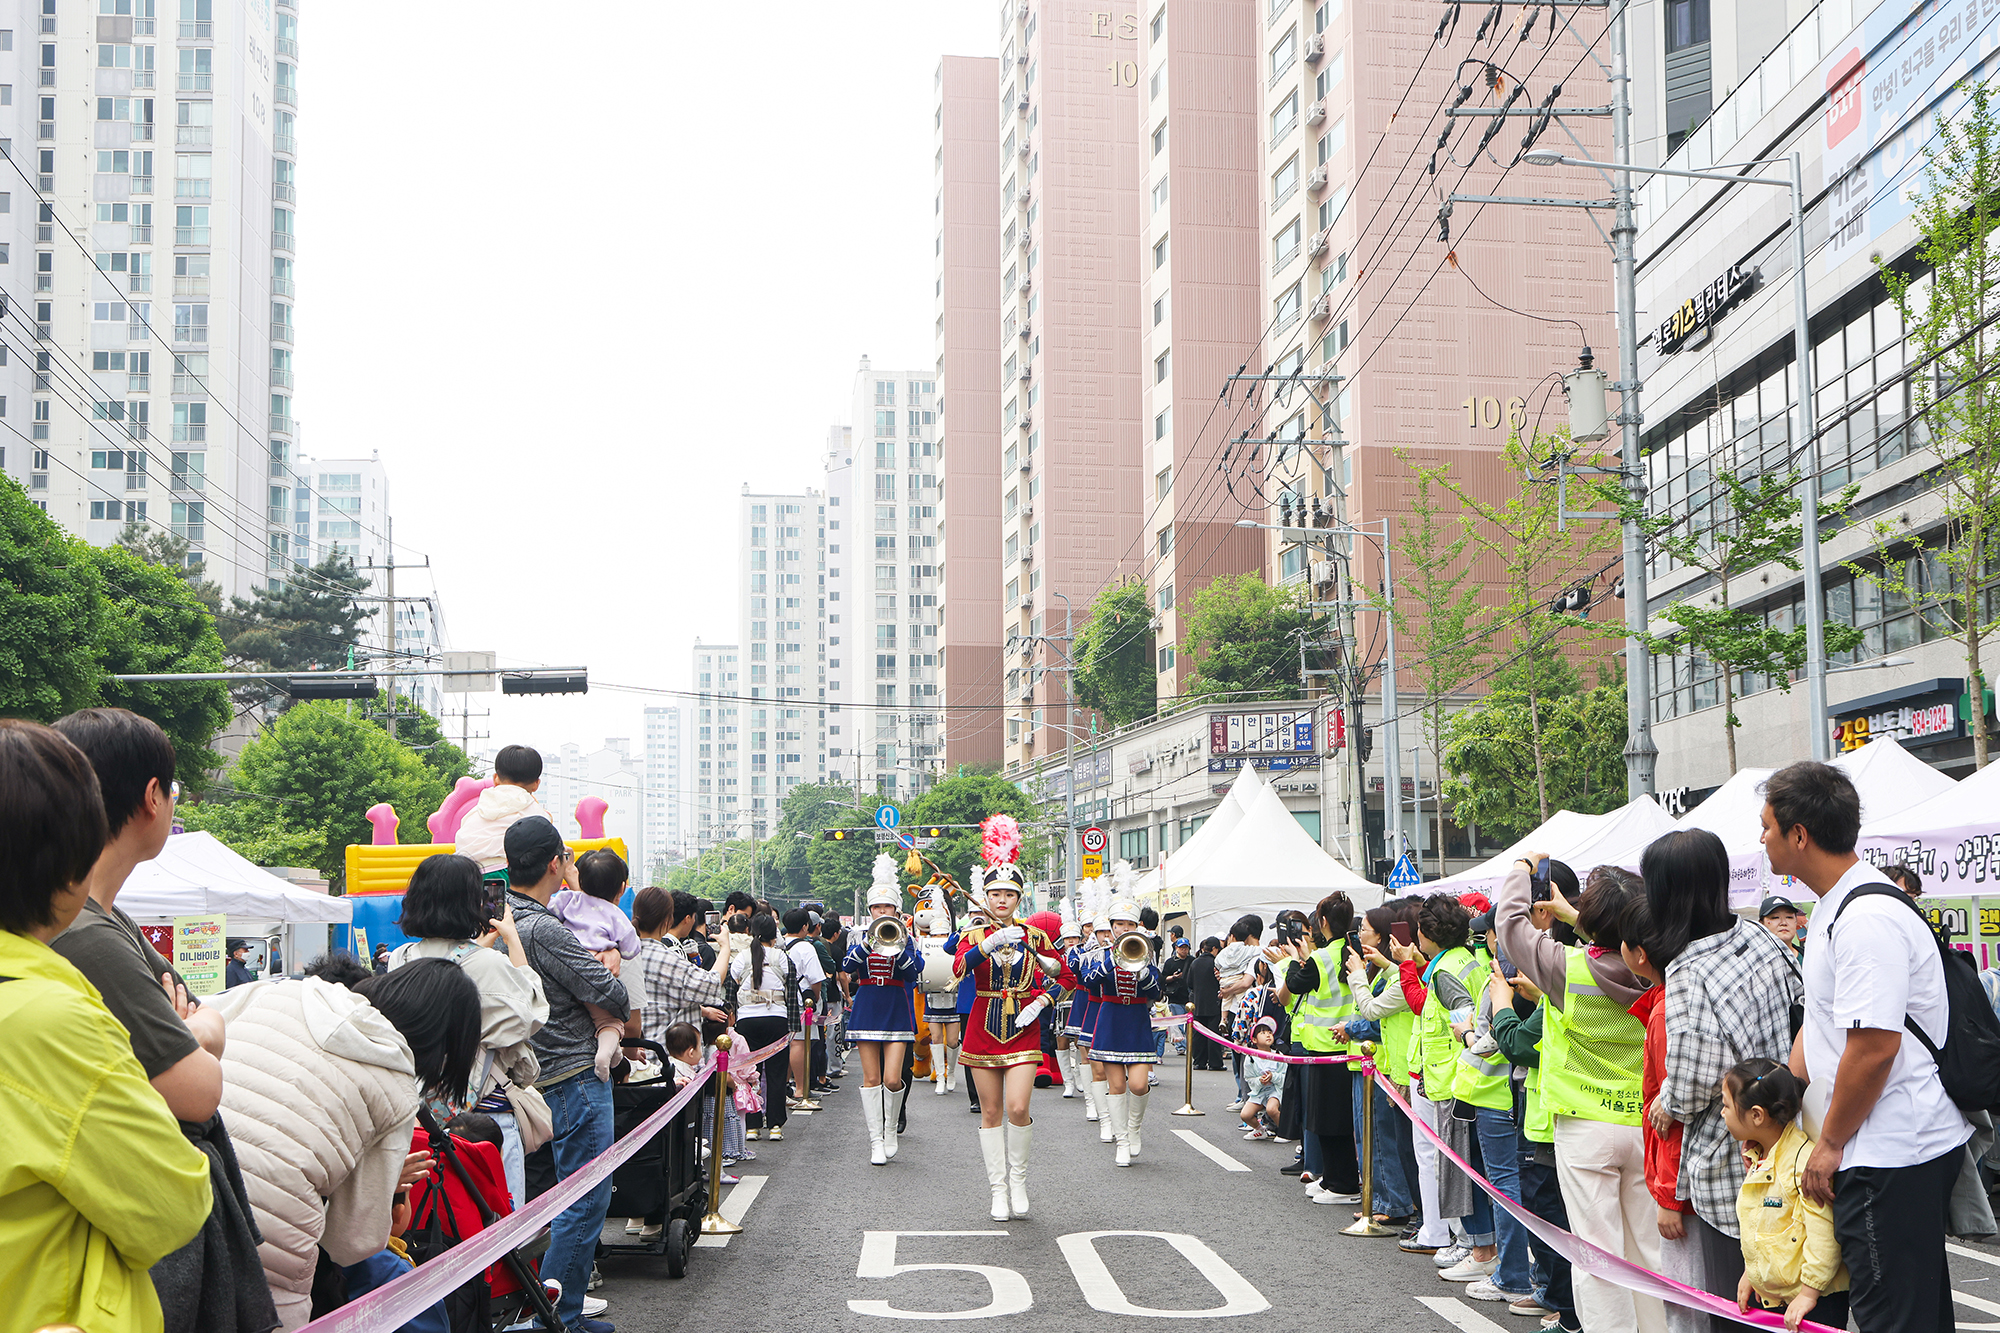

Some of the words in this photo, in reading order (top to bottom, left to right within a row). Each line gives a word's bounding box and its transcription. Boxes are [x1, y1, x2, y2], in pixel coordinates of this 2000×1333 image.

[1872, 69, 1898, 112] 안녕!
[1901, 36, 1935, 87] 친구들
[1938, 12, 1962, 54] 우리
[253, 91, 266, 125] 108
[1461, 395, 1528, 431] 106
[1230, 717, 1240, 750] 치과
[1247, 716, 1257, 750] 안과
[1265, 716, 1274, 749] 피부과
[1281, 715, 1291, 748] 한의원
[1911, 704, 1949, 738] 954-1234
[1659, 786, 1687, 815] KFC
[1087, 834, 1102, 846] 50
[1579, 1083, 1613, 1098] (사)한국
[1616, 1089, 1641, 1099] 청소년
[1863, 1186, 1877, 1242] ARMOUR
[846, 1230, 1273, 1320] 50
[1868, 1242, 1881, 1286] UNDER
